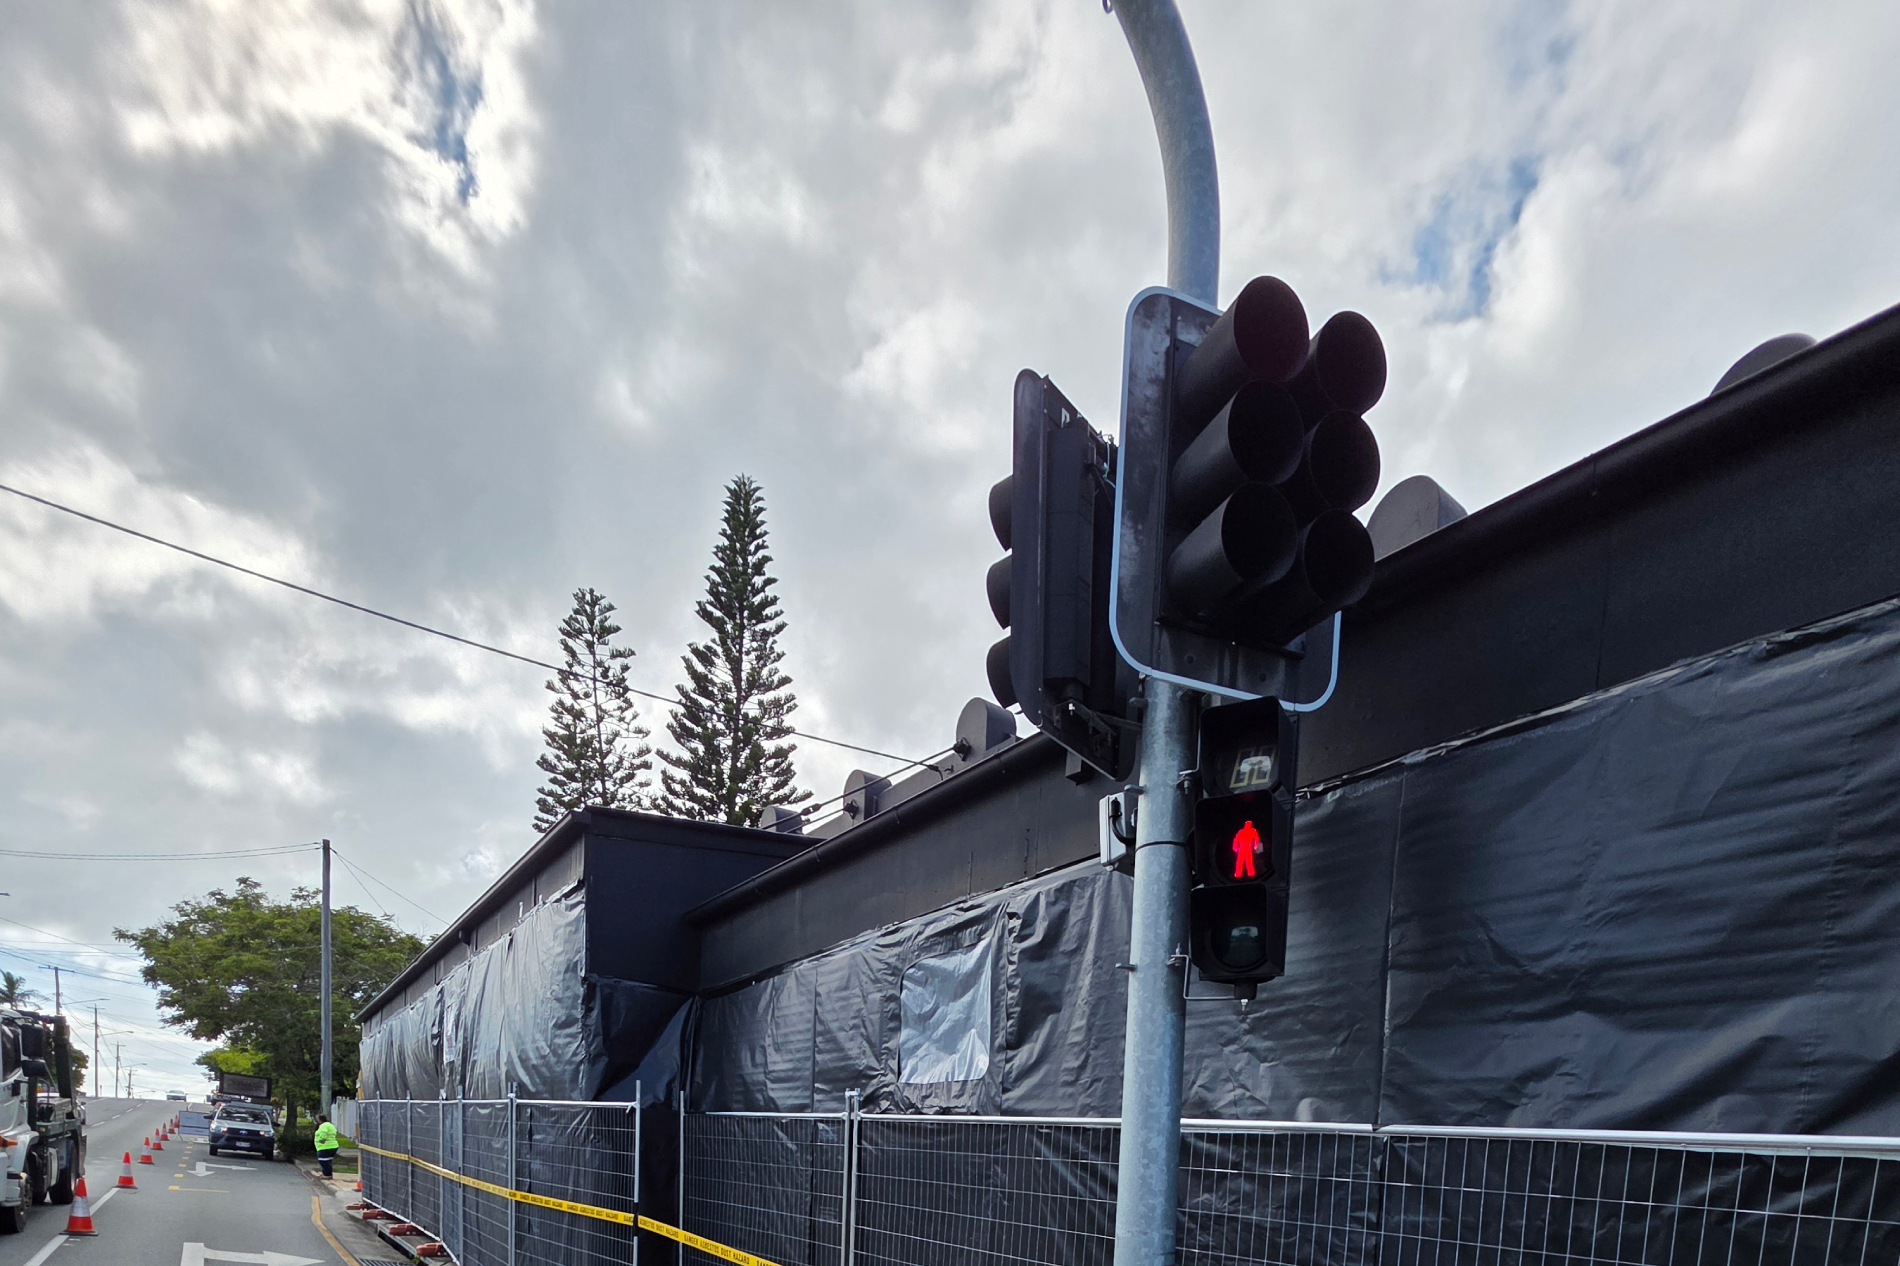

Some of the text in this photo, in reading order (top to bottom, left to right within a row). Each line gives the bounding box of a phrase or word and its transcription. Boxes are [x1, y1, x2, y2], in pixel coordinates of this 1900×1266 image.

[684, 1234, 699, 1245] DANGER
[721, 1247, 732, 1258] DUST
[733, 1252, 750, 1265] HAZARD
